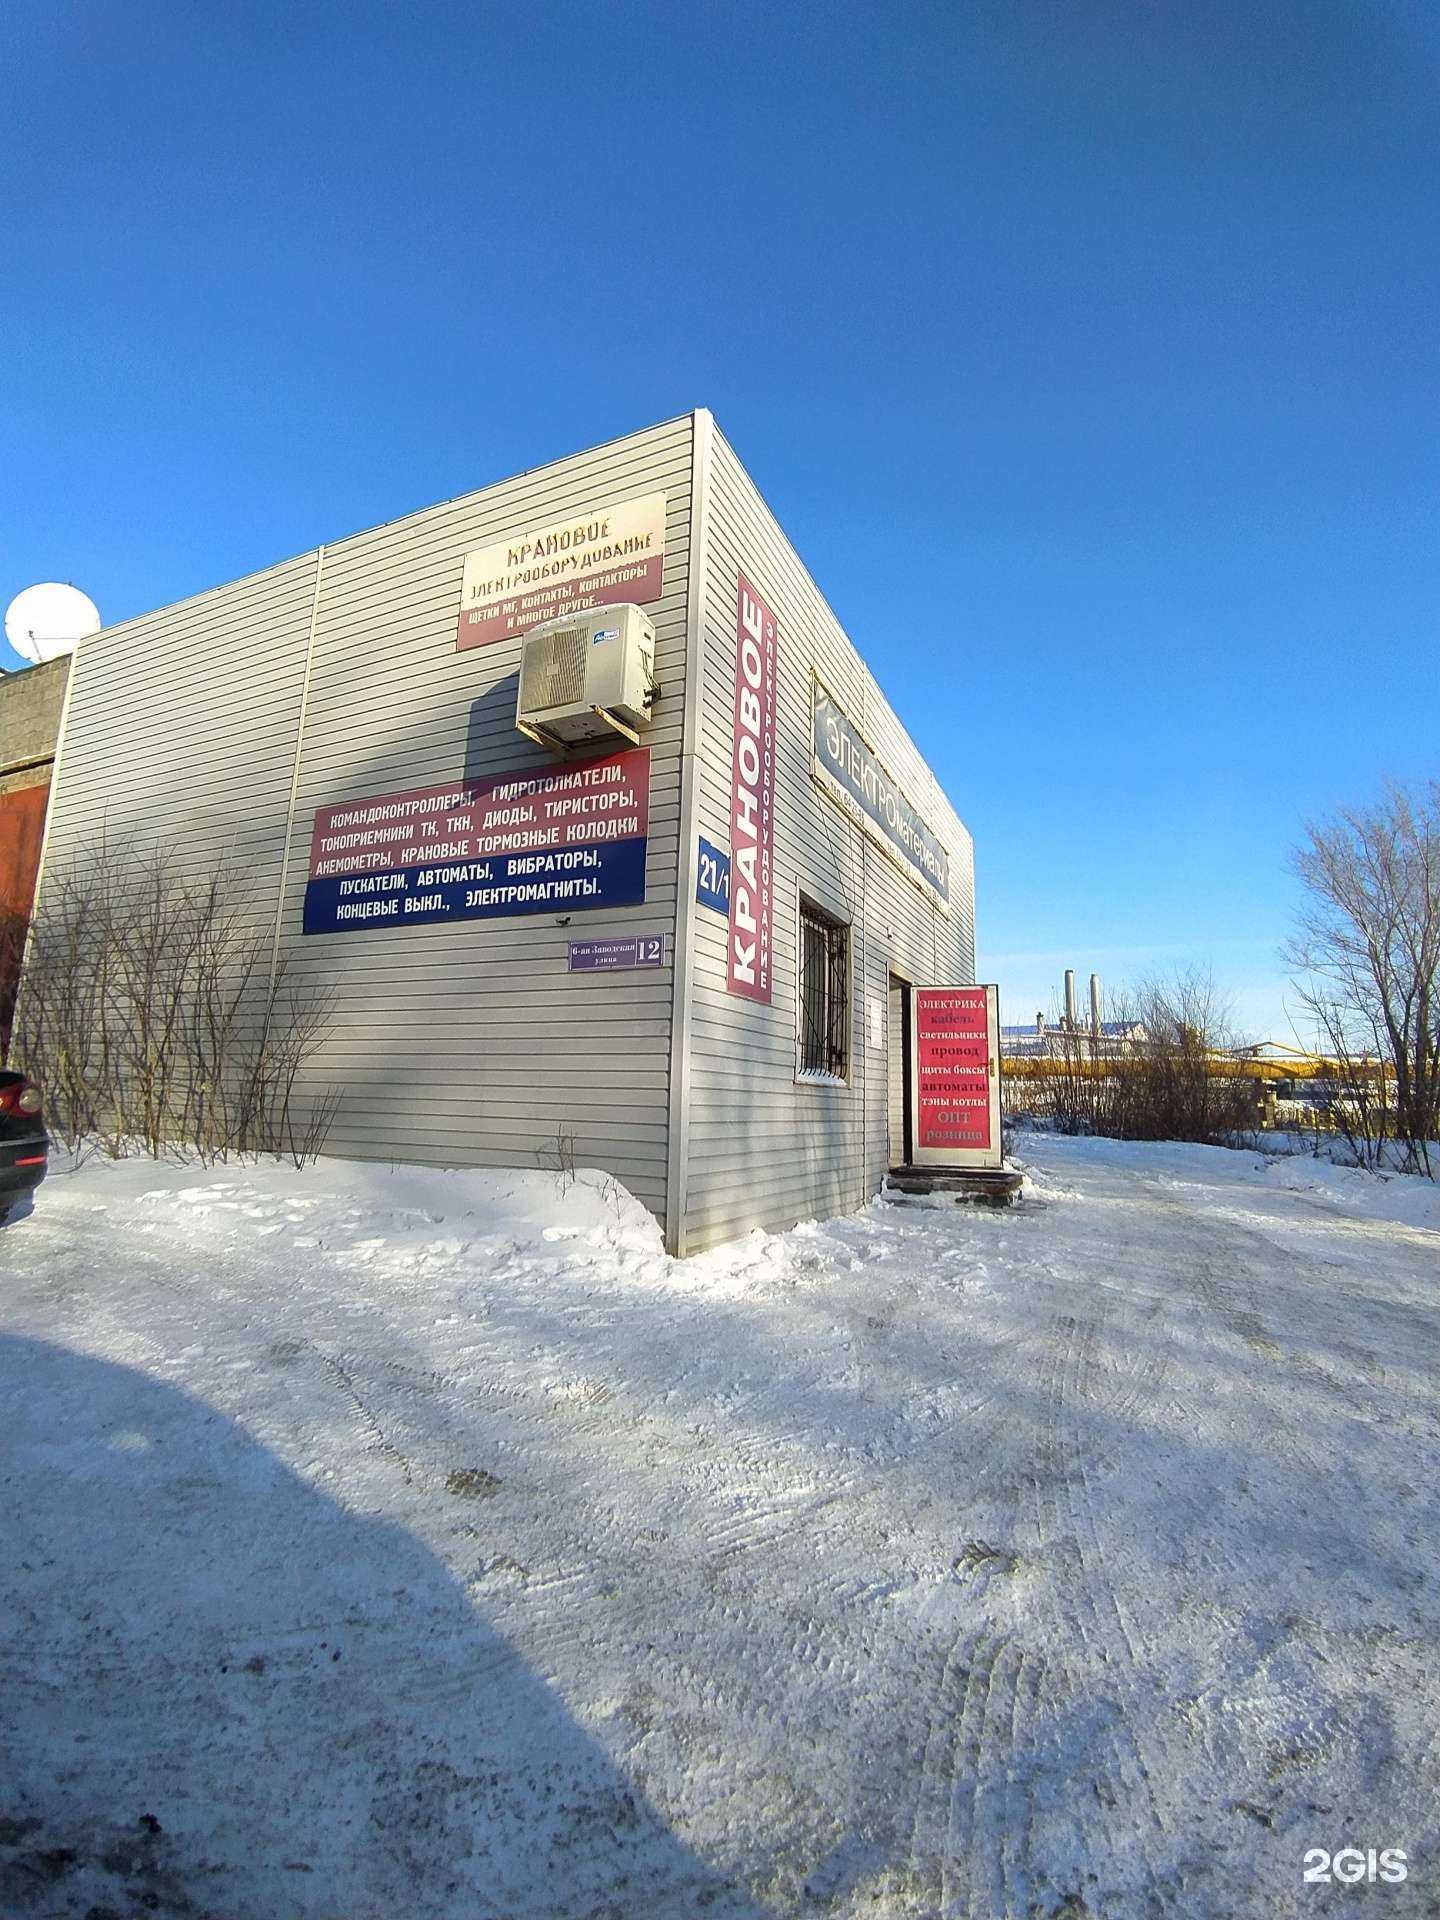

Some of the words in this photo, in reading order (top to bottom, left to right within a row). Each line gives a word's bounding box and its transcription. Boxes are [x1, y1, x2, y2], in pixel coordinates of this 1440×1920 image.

[507, 518, 610, 567] КРАНОВОЕ
[471, 532, 653, 599] ЭЛЕКТРООБОРУДОВАНИЕ
[469, 605, 499, 624] ЩЕТКИ
[502, 601, 518, 617] МГ,
[522, 585, 575, 609] КОНТАКТЫ,
[579, 565, 647, 591] КОНТАКТОРЫ
[507, 617, 514, 629] И
[517, 608, 555, 626] МНОГОЕ
[558, 597, 603, 616] ДРУГОЕ...
[329, 789, 476, 830] КОМАНДОКОНТРОЛЛЕРЫ,
[492, 764, 626, 803] ГИДРОТОЛКАТЕЛИ,
[734, 589, 763, 986] КРАНОВОЕ
[760, 620, 775, 990] ЭЛЕКТРООБОРУДОВАНИЕ
[320, 824, 414, 852] ТОКОПРИЕМНИКИ
[421, 820, 438, 838] ТК,
[446, 815, 473, 835] ТКН,
[482, 803, 537, 830] ДИОДЫ,
[545, 788, 638, 819] ТИРИСТОРЫ,
[316, 848, 395, 876] АНЕМОМЕТРЫ,
[401, 838, 469, 864] КРАНОВЫЕ
[477, 826, 559, 852] ТОРМОЗНЫЕ
[566, 816, 638, 842] КОЛОДКИ
[340, 872, 408, 896] ПУСКАТЕЛИ,
[417, 862, 494, 887] АВТОМАТЫ,
[507, 849, 602, 876] ВИБРАТОРЫ,
[700, 853, 729, 898] 21/1
[337, 893, 398, 920] КОНЦЕВЫЕ
[404, 892, 450, 914] ВЫКЛ.,
[466, 877, 602, 908] ЭЛЕКТРОМАГНИТЫ.
[592, 945, 635, 954] Заводская
[595, 957, 617, 965] улица
[638, 941, 660, 960] 12
[920, 999, 985, 1009] ЭЛЕКТРИКА
[931, 1012, 975, 1024] кабель
[920, 1029, 986, 1040] светильники
[931, 1047, 979, 1058] провод
[921, 1067, 951, 1075] щиты
[954, 1064, 986, 1075] боксы
[922, 1083, 986, 1092] автоматы
[921, 1097, 949, 1106] тэны
[952, 1098, 986, 1107] котлы
[937, 1111, 971, 1123] ОПТ
[926, 1130, 983, 1142] розница
